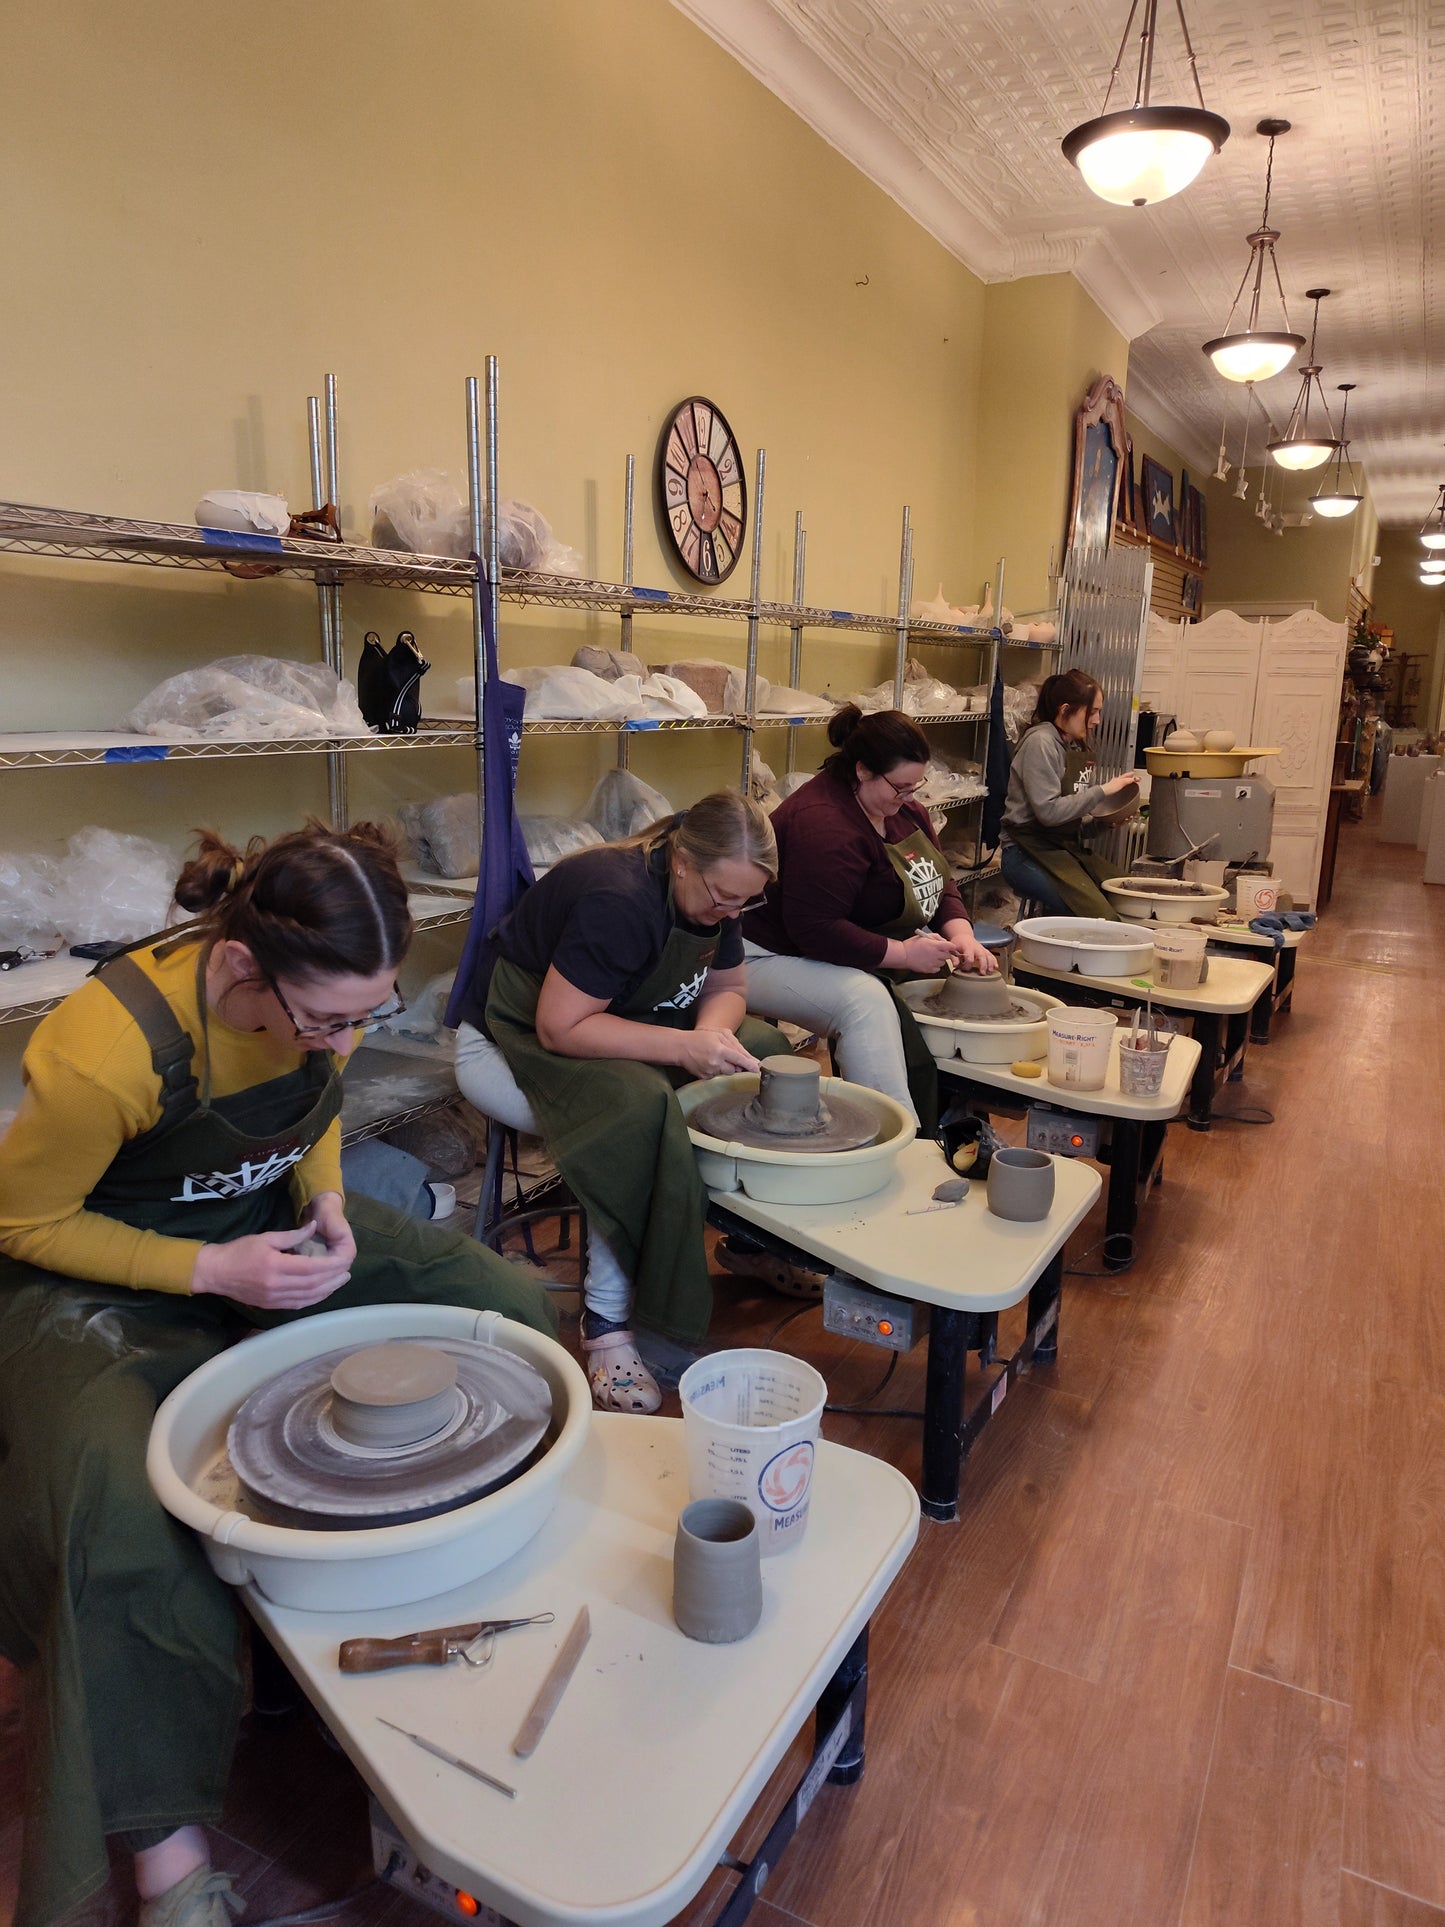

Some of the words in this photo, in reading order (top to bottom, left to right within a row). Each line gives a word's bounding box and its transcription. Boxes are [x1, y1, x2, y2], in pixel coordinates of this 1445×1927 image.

[719, 458, 733, 481] 2
[673, 509, 687, 532] 8
[687, 528, 699, 558] 7
[702, 539, 711, 572] 6
